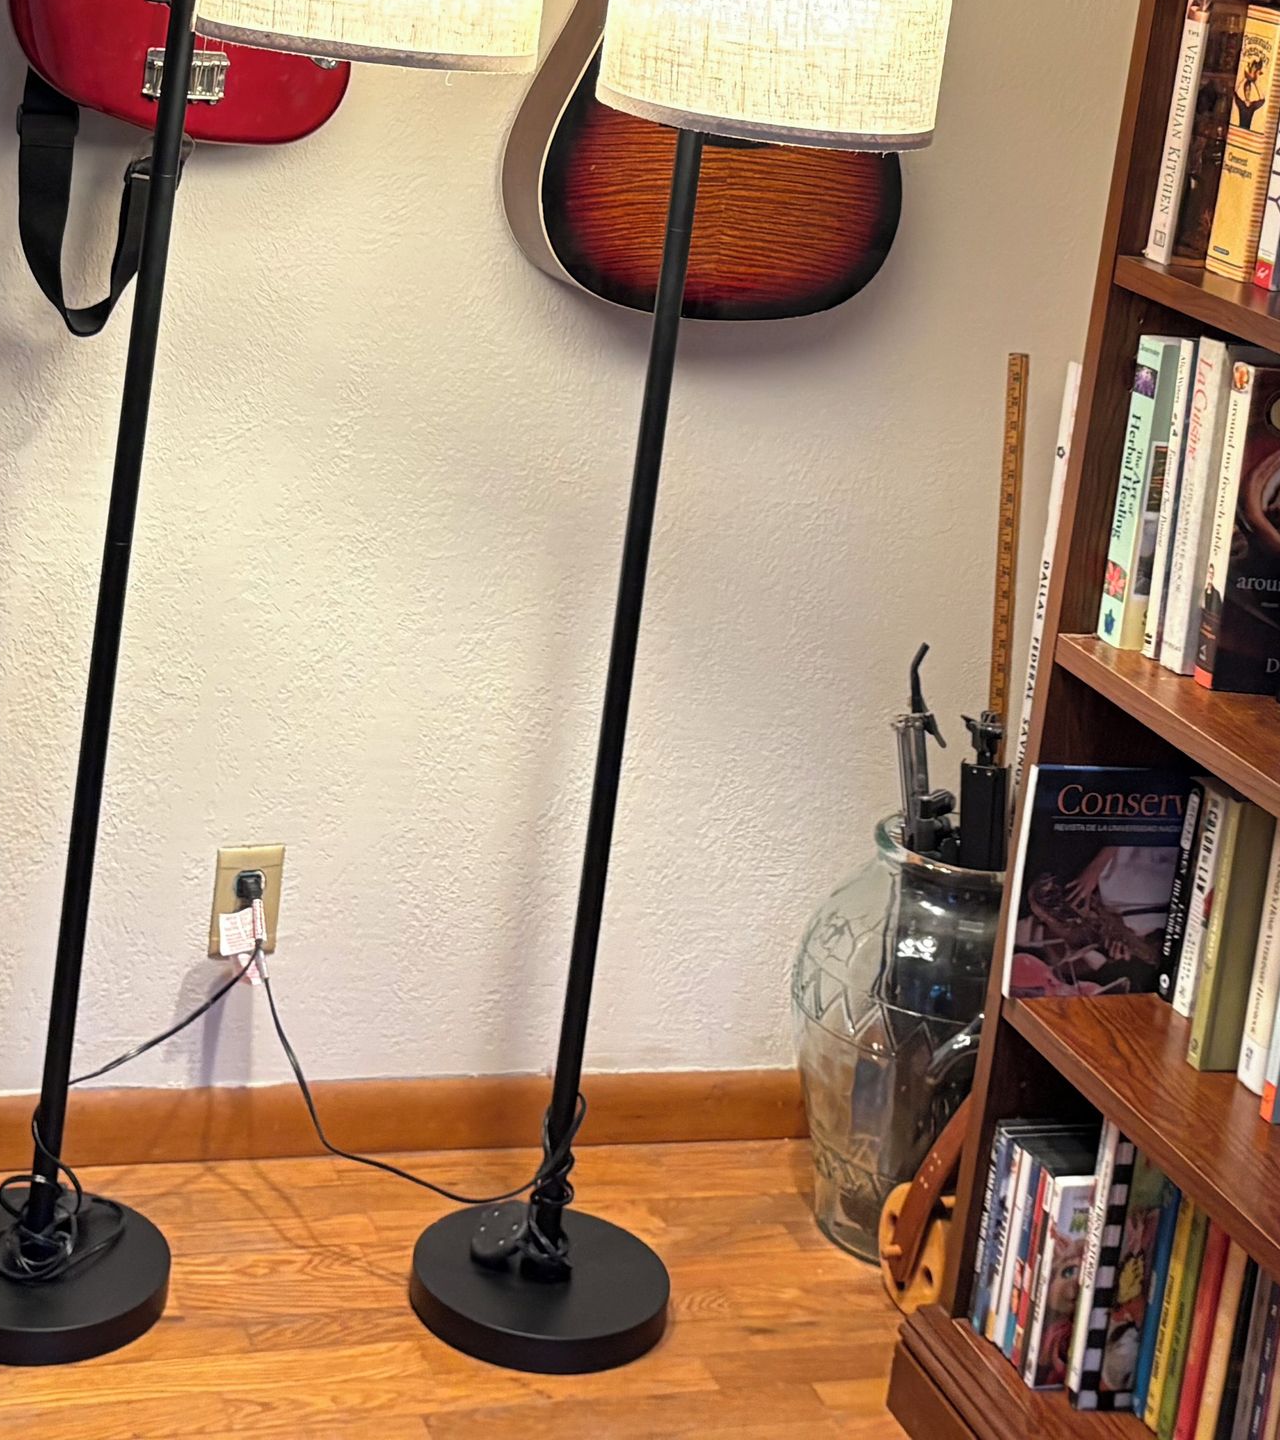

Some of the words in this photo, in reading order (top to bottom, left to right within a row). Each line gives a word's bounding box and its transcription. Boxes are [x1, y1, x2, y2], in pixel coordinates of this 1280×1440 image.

[1167, 42, 1200, 139] VEGETARIAN
[1154, 145, 1182, 215] KITCHEN
[1195, 357, 1212, 386] La
[1119, 413, 1144, 471] Herbal
[1185, 388, 1208, 462] Cuisine
[1225, 399, 1241, 448] around
[1133, 448, 1144, 469] The
[1220, 451, 1233, 472] my
[1127, 471, 1142, 499] Art
[1216, 475, 1231, 514] french
[1109, 475, 1136, 541] Healing
[1125, 501, 1136, 515] of
[1210, 518, 1225, 556] table
[1033, 560, 1051, 620] DALLAS
[1022, 636, 1041, 700] FEDERAL
[1201, 809, 1218, 853] COLOR
[1194, 866, 1208, 895] LAW
